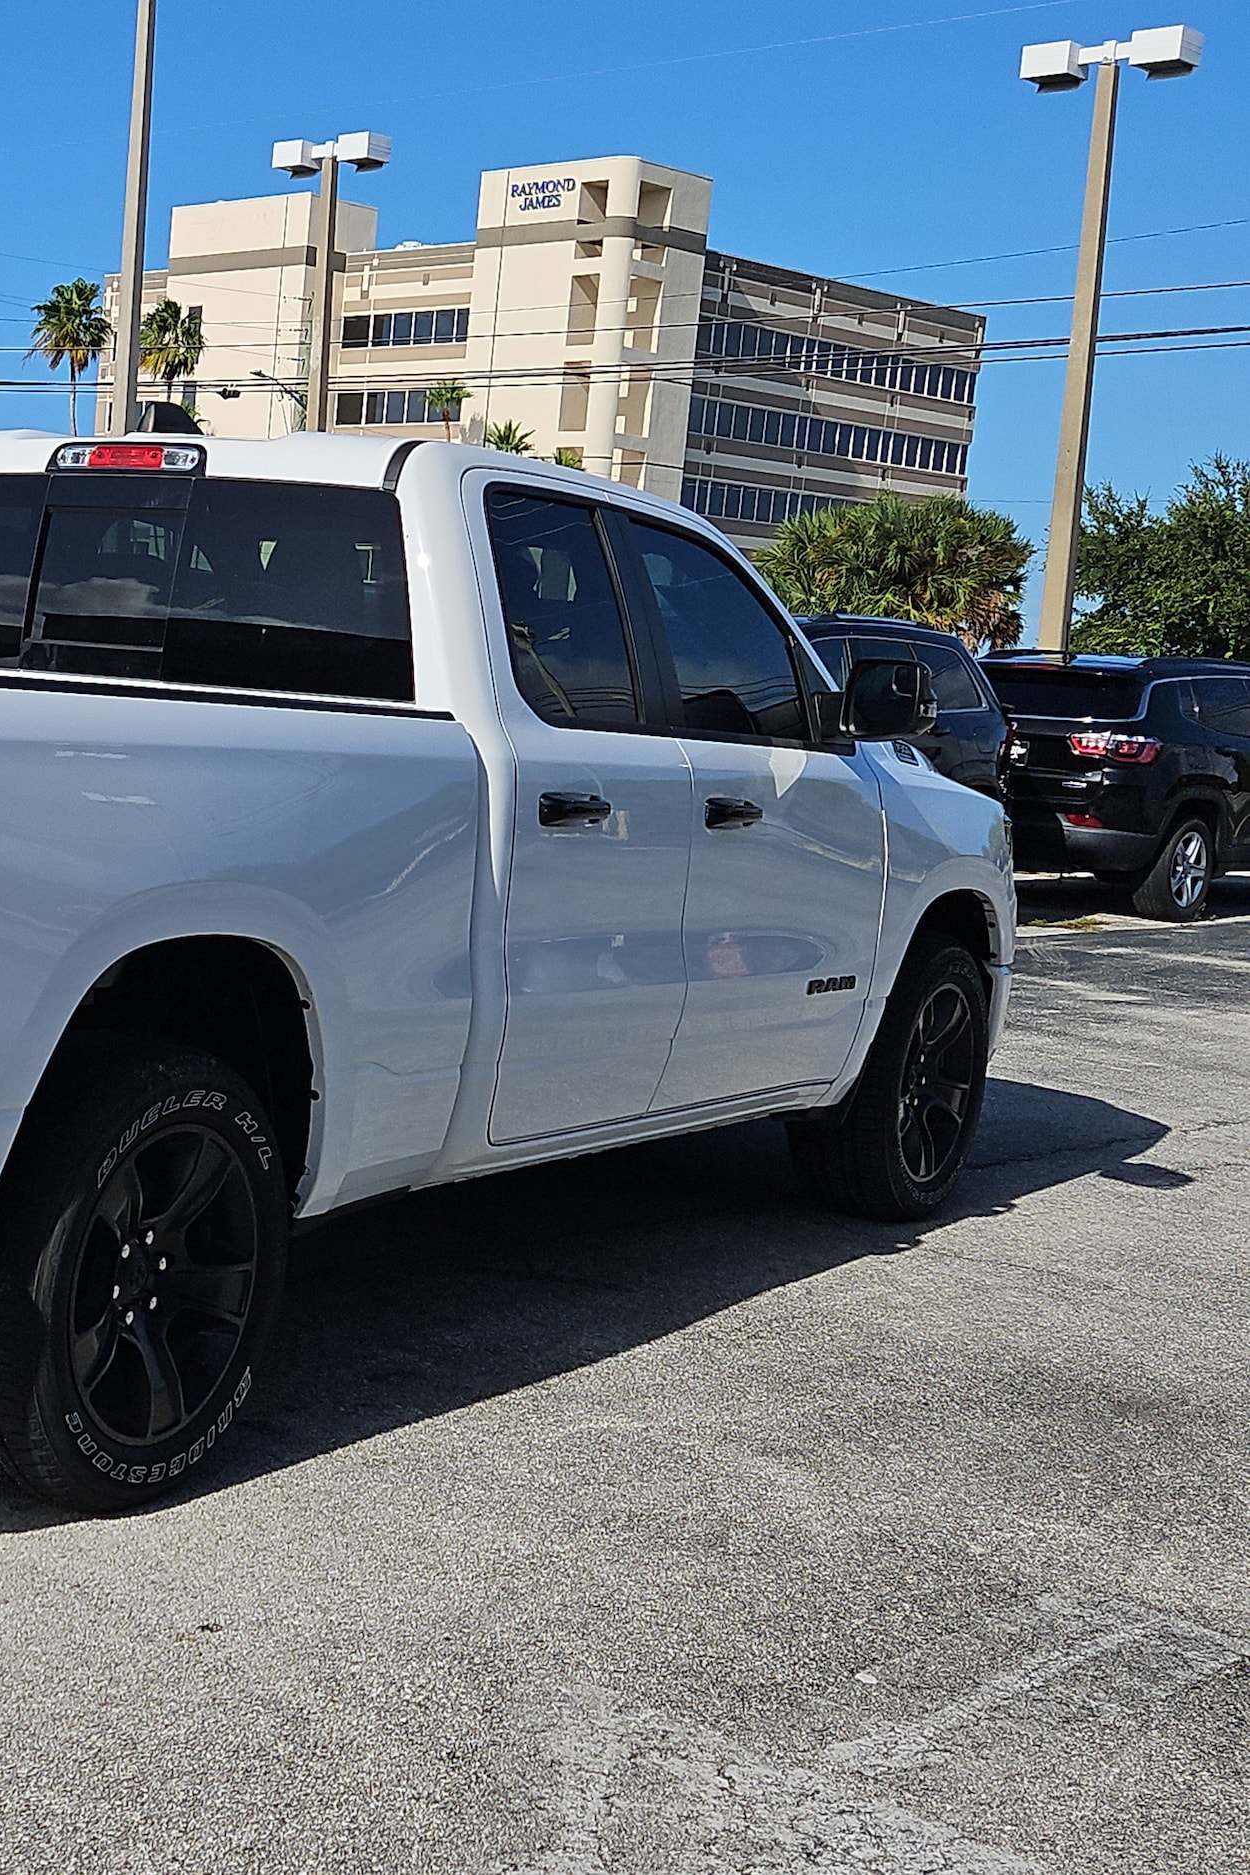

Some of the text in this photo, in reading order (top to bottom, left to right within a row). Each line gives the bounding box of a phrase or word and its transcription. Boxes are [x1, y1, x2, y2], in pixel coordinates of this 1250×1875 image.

[511, 178, 576, 198] RAYMOND
[519, 194, 561, 211] JAMES
[807, 975, 856, 995] RAM
[98, 1090, 227, 1188] DUELER
[65, 1366, 251, 1483] BRIDGESTONE
